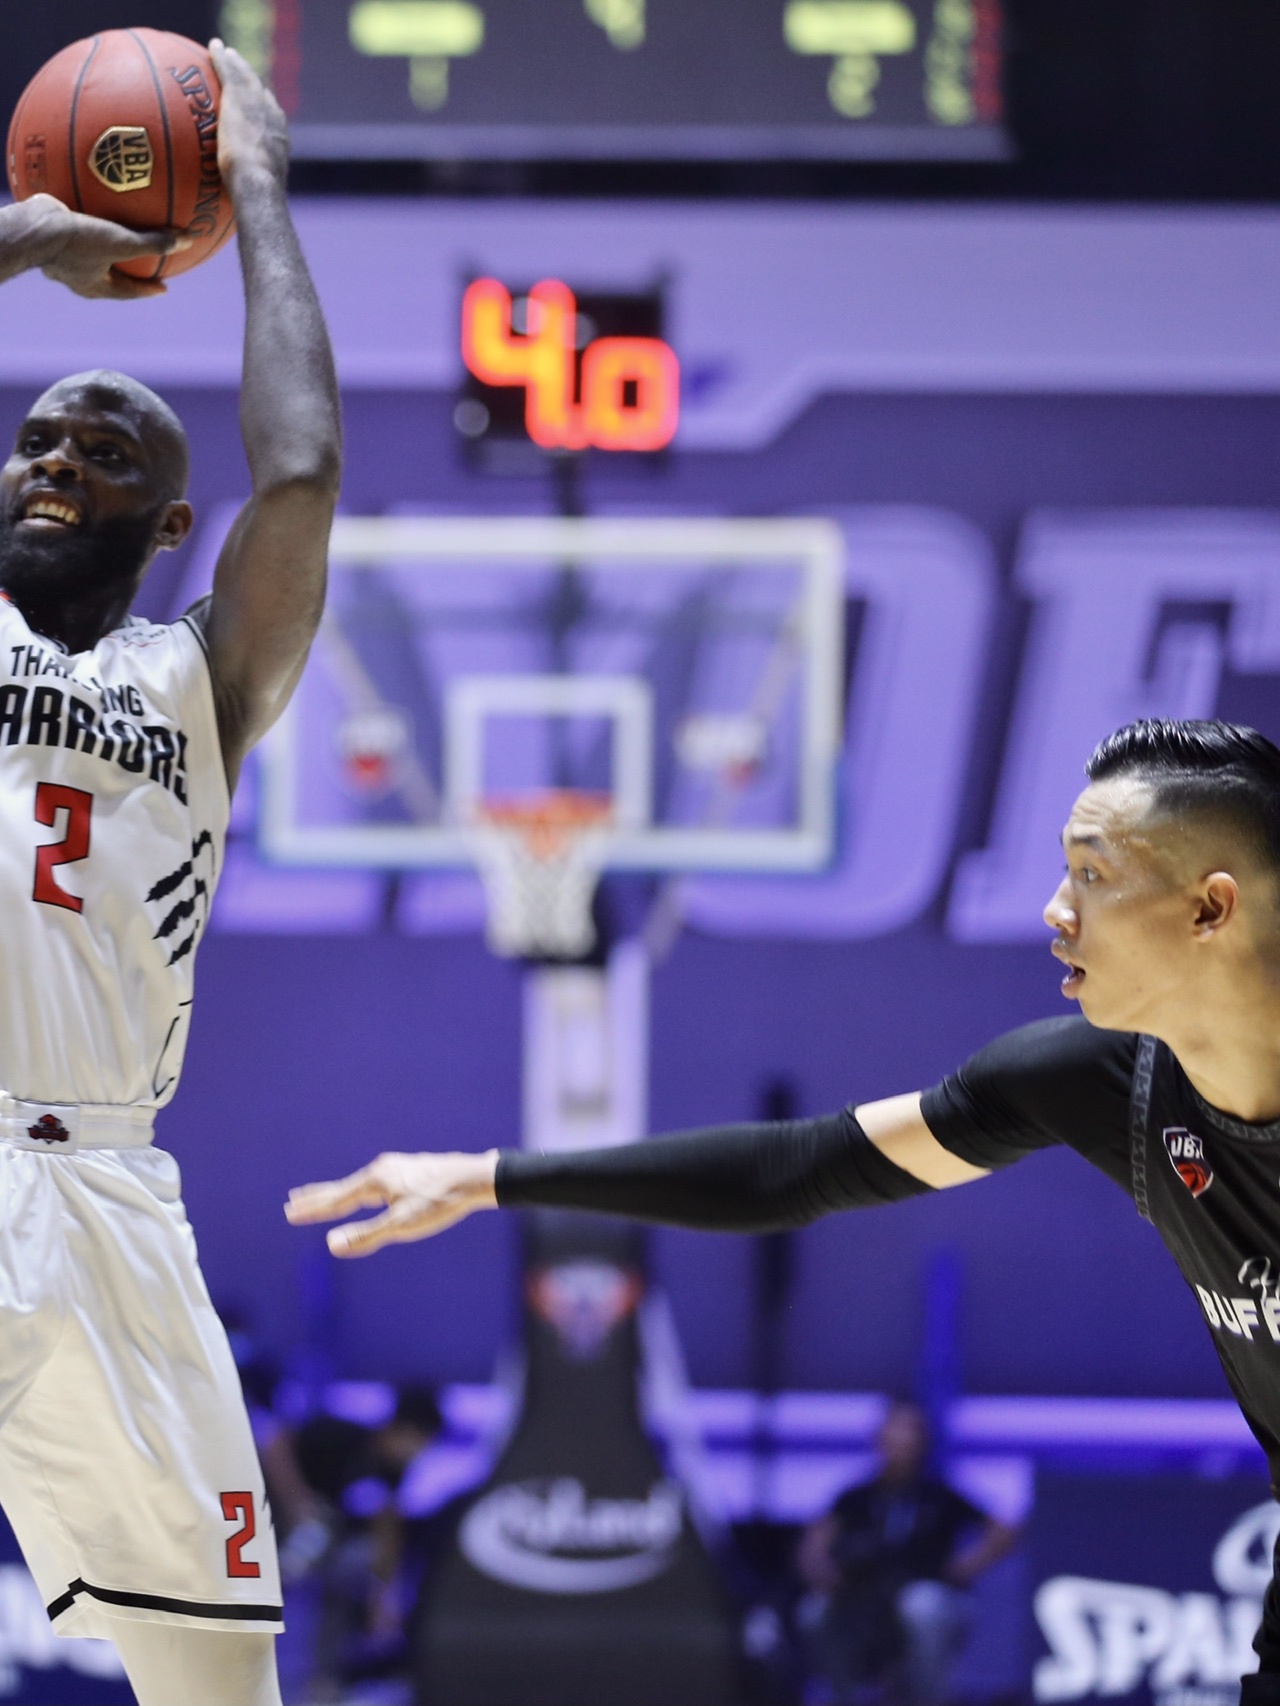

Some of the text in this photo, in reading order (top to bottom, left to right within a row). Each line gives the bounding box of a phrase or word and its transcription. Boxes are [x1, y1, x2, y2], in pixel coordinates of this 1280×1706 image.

[123, 131, 149, 183] VBA
[169, 65, 222, 237] SPALDING
[11, 644, 93, 691] THA
[32, 782, 94, 914] 2
[220, 1491, 261, 1578] 2
